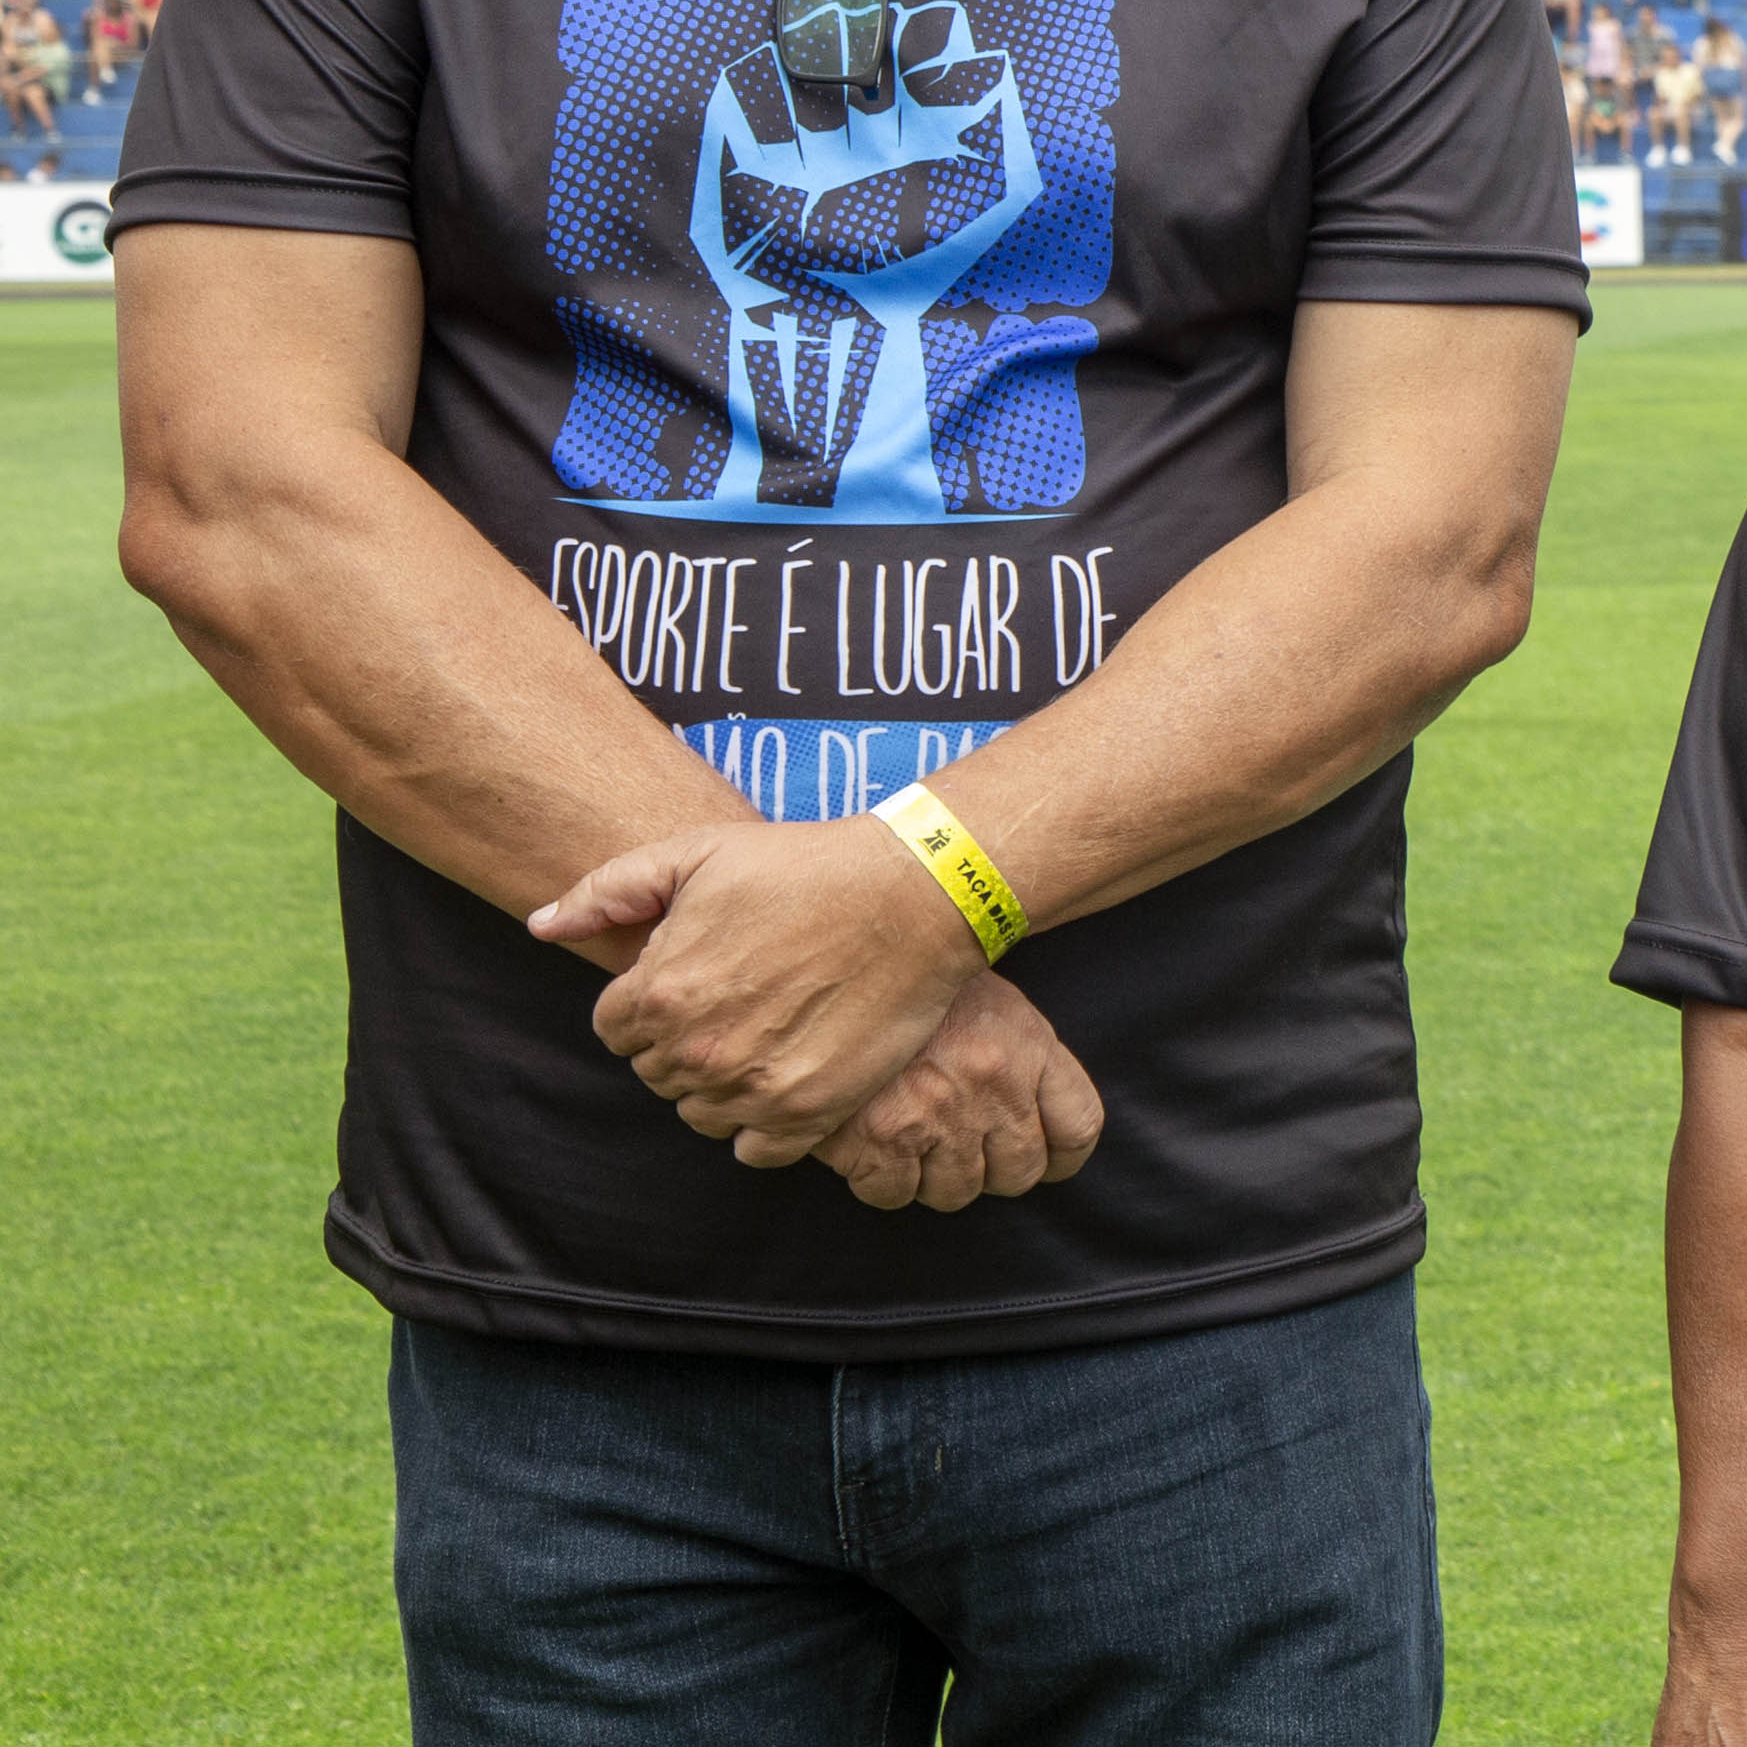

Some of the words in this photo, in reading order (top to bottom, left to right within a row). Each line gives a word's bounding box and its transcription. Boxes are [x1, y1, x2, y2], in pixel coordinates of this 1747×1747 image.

[551, 537, 757, 694] ESPORTE
[776, 537, 814, 695] É
[837, 557, 1022, 698] LUGAR
[1050, 546, 1118, 686] DE
[818, 727, 890, 821] DE
[956, 857, 993, 906] TAÇA
